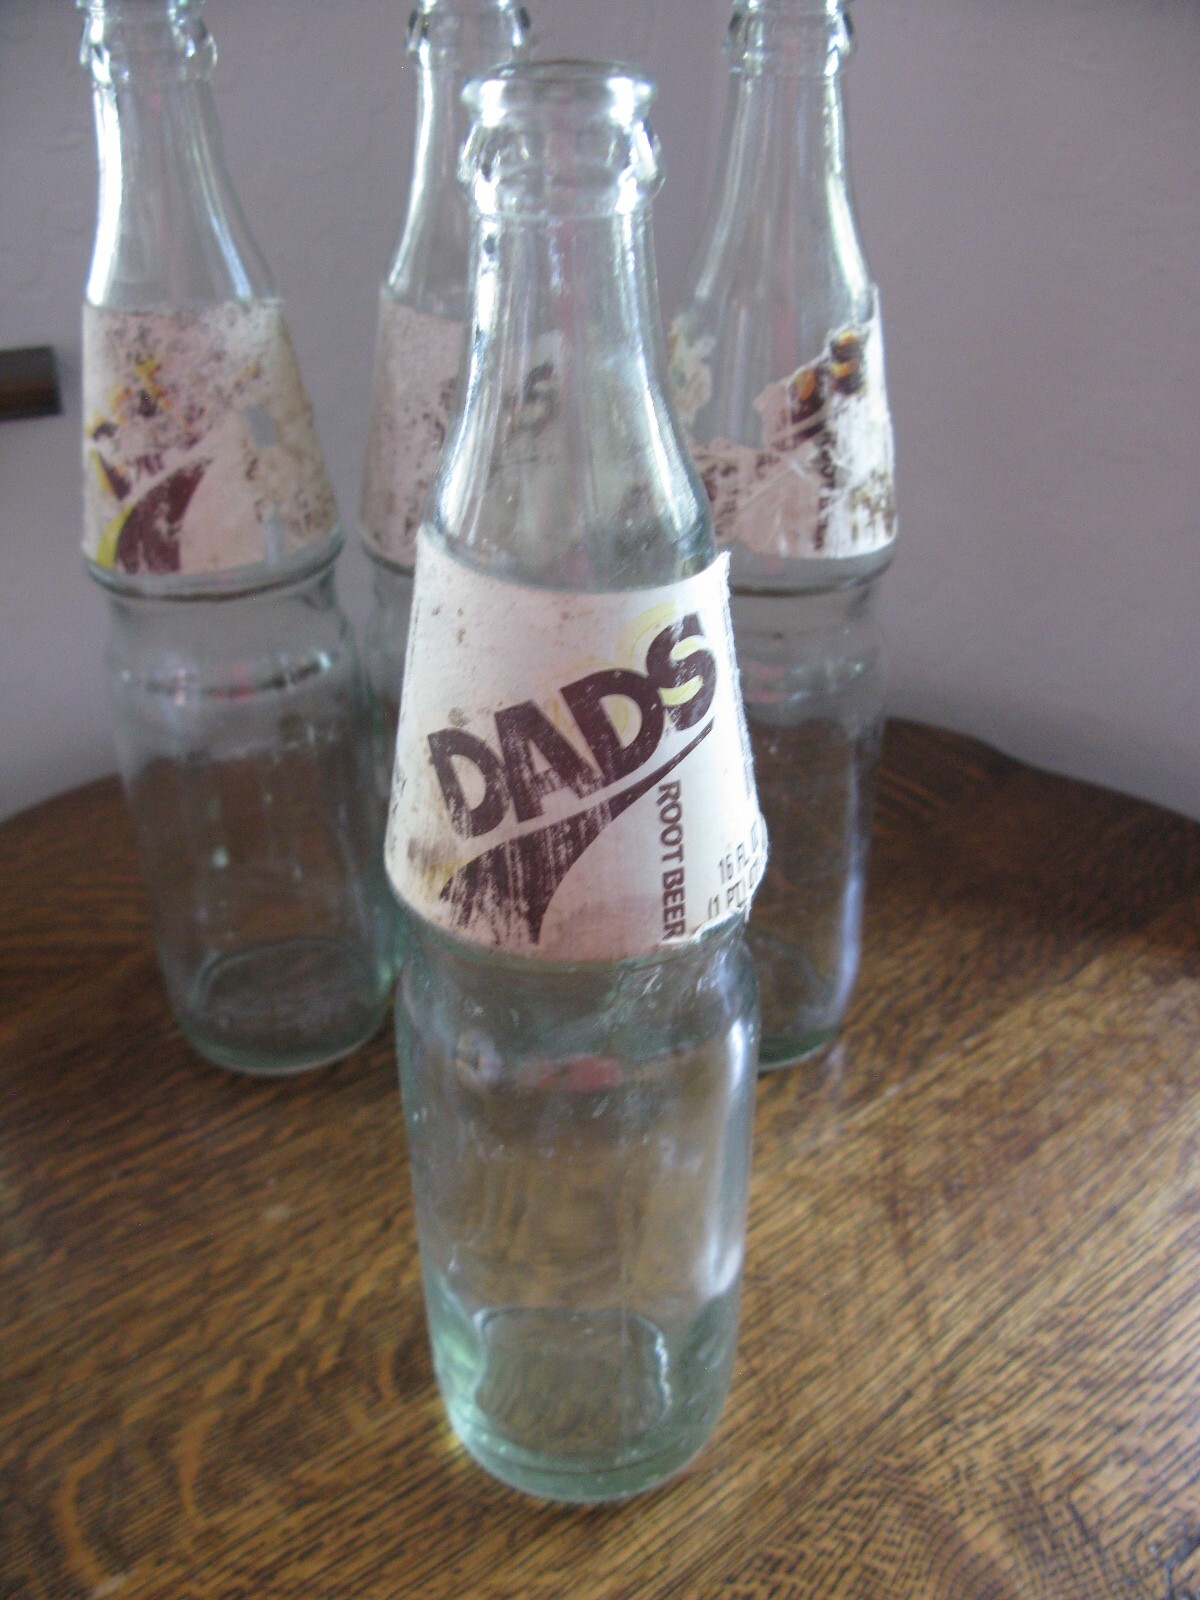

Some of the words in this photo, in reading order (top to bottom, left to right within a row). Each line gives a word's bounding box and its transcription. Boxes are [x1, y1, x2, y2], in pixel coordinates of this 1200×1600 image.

[427, 612, 717, 838] DADS
[656, 779, 684, 863] ROOT
[662, 866, 686, 940] BEER
[718, 853, 734, 884] 16
